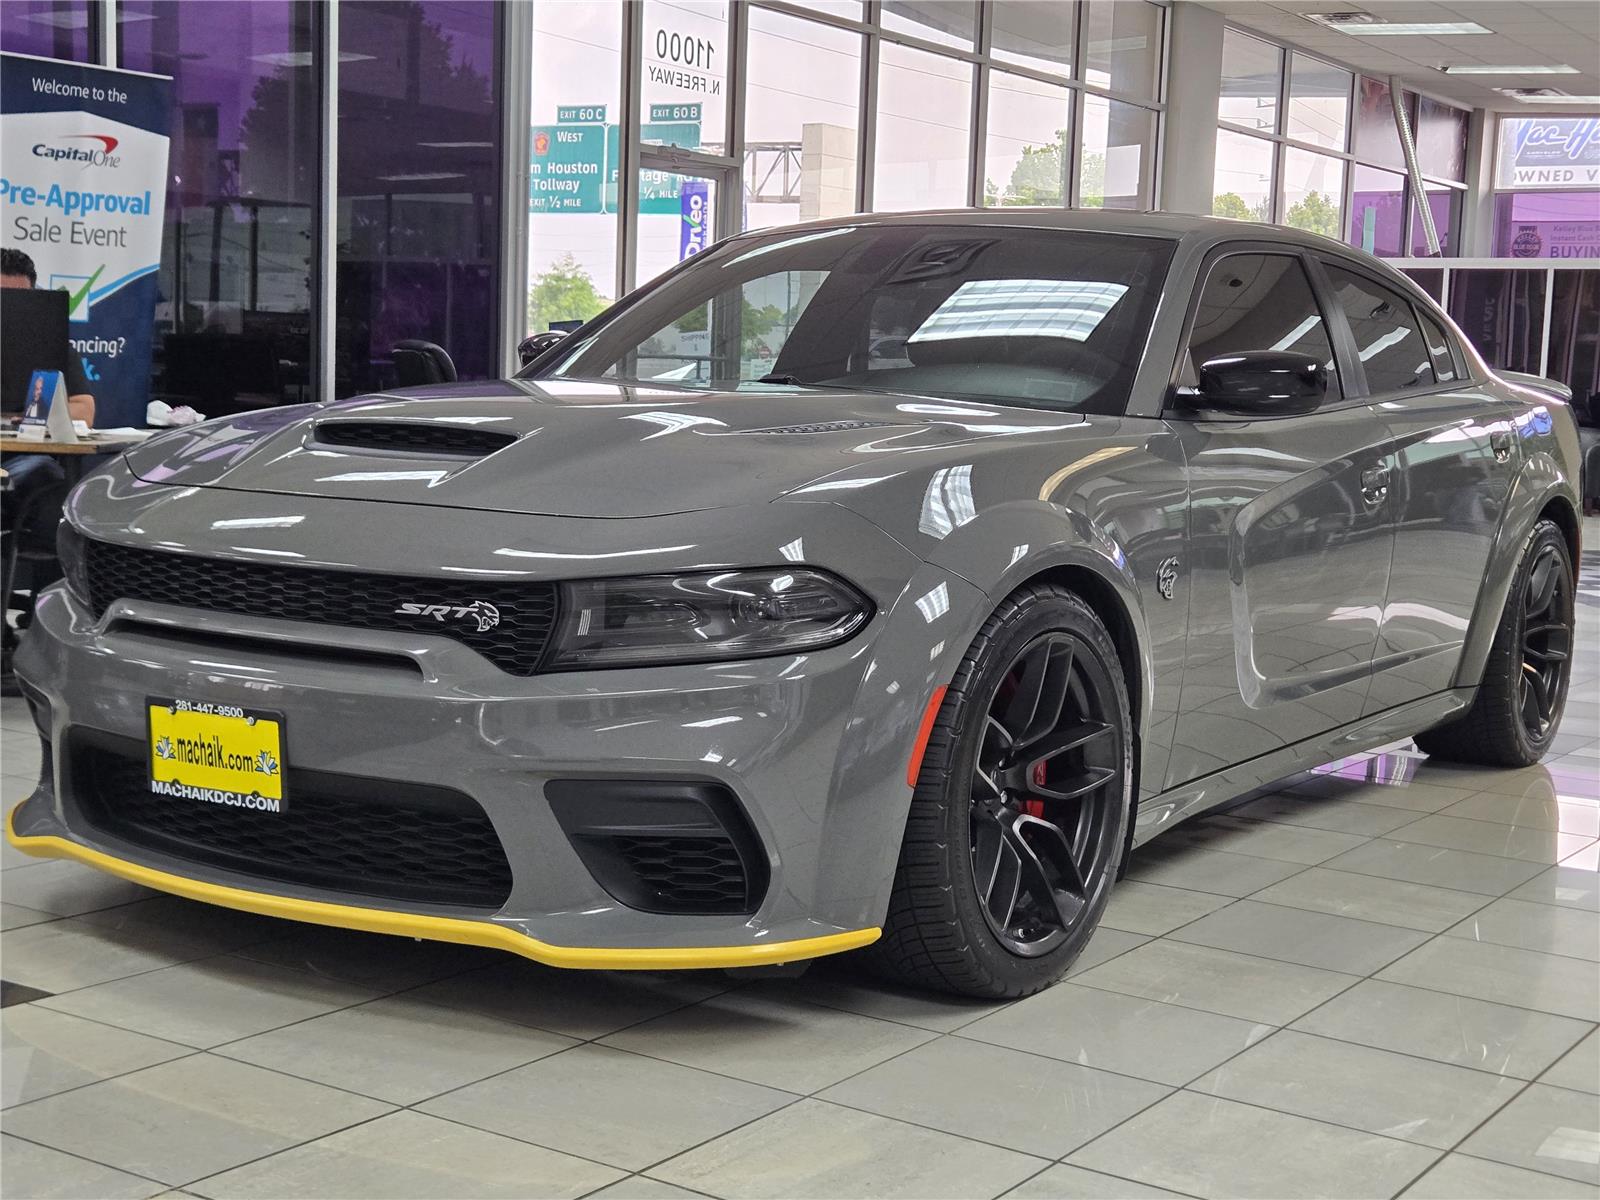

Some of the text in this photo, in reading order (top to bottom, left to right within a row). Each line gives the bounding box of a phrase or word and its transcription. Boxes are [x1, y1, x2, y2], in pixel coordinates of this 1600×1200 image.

[32, 77, 128, 104] Welcome to the
[560, 110, 576, 119] EXIT
[652, 109, 669, 118] EXIT
[557, 131, 583, 142] WEST
[547, 161, 598, 174] Houston
[1514, 169, 1574, 182] WNED
[611, 168, 669, 185] Ftage
[533, 178, 580, 194] Tollway
[659, 189, 679, 199] MILE
[563, 198, 582, 207] MILE
[13, 216, 127, 248] Sale Event
[395, 603, 479, 621] SRT
[175, 700, 244, 718] 281-447-9500
[176, 733, 254, 773] machaik.com
[152, 780, 280, 812] MACHAIKDCJ.COM
